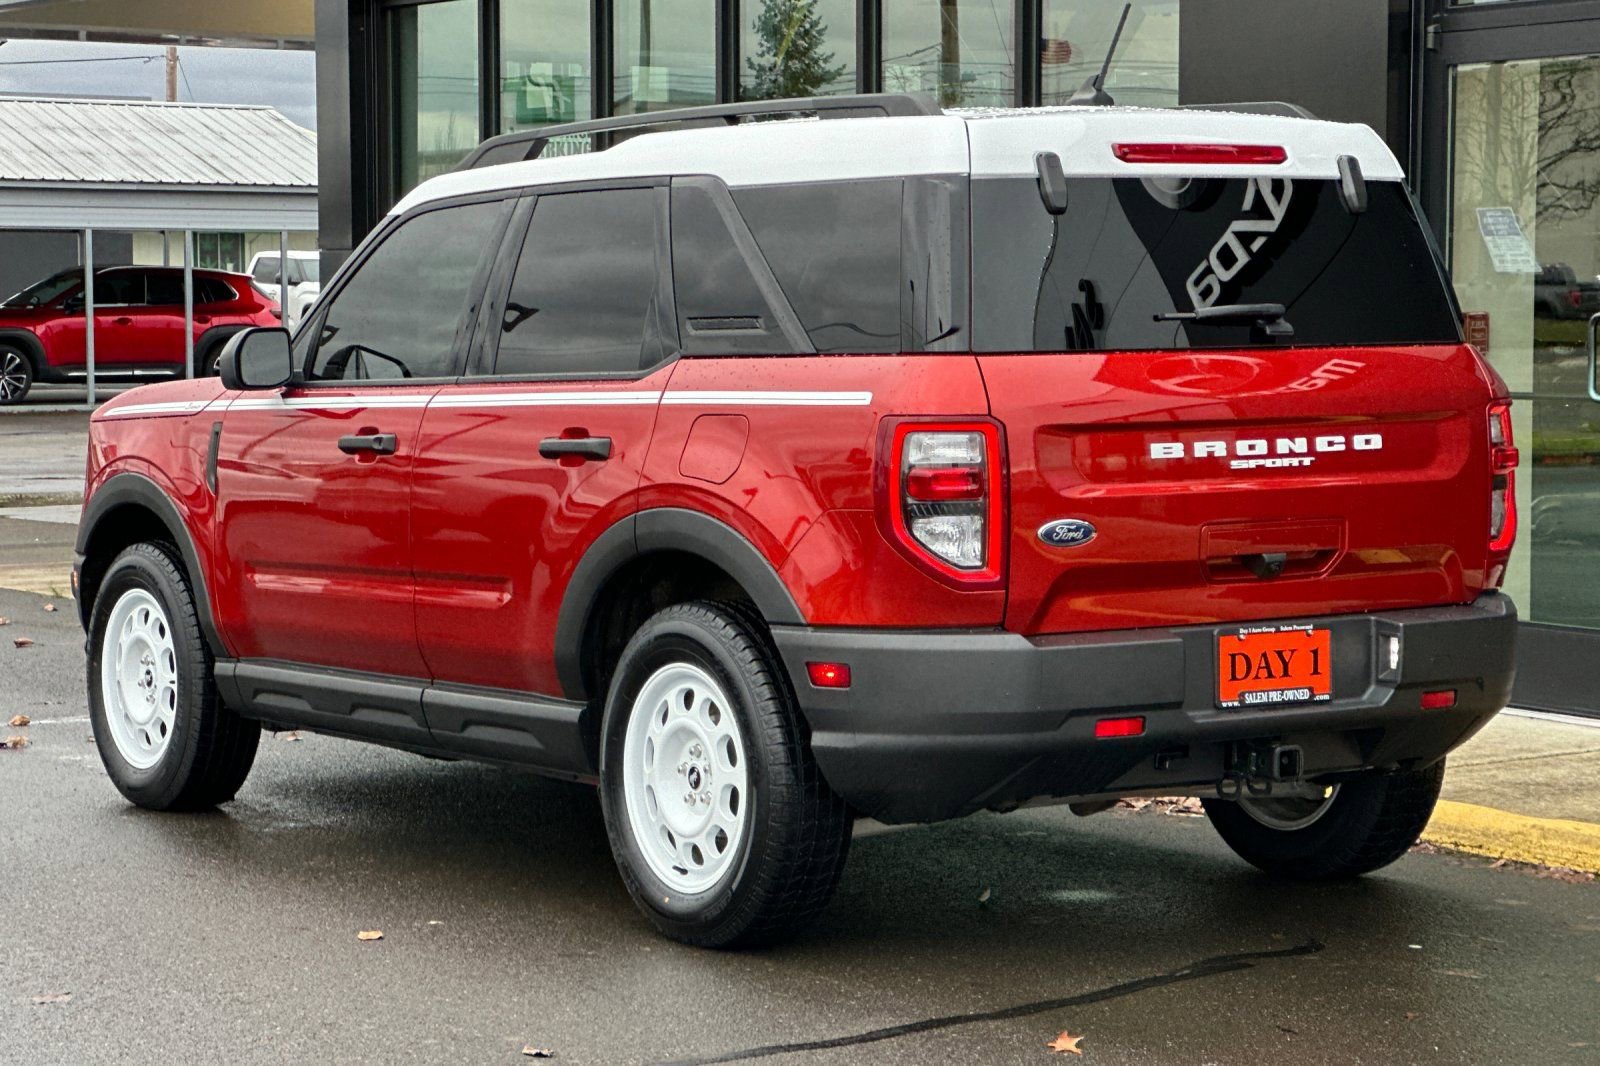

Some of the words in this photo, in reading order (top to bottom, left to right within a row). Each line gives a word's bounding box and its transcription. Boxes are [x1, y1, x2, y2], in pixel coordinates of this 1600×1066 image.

[1150, 434, 1383, 459] BRONCO
[1230, 457, 1315, 469] SPORT
[1052, 525, 1085, 540] Ford
[1228, 649, 1298, 681] DAY
[1309, 647, 1322, 675] 1
[1244, 692, 1267, 704] SALEM
[1268, 688, 1310, 702] PRE-OWNED
